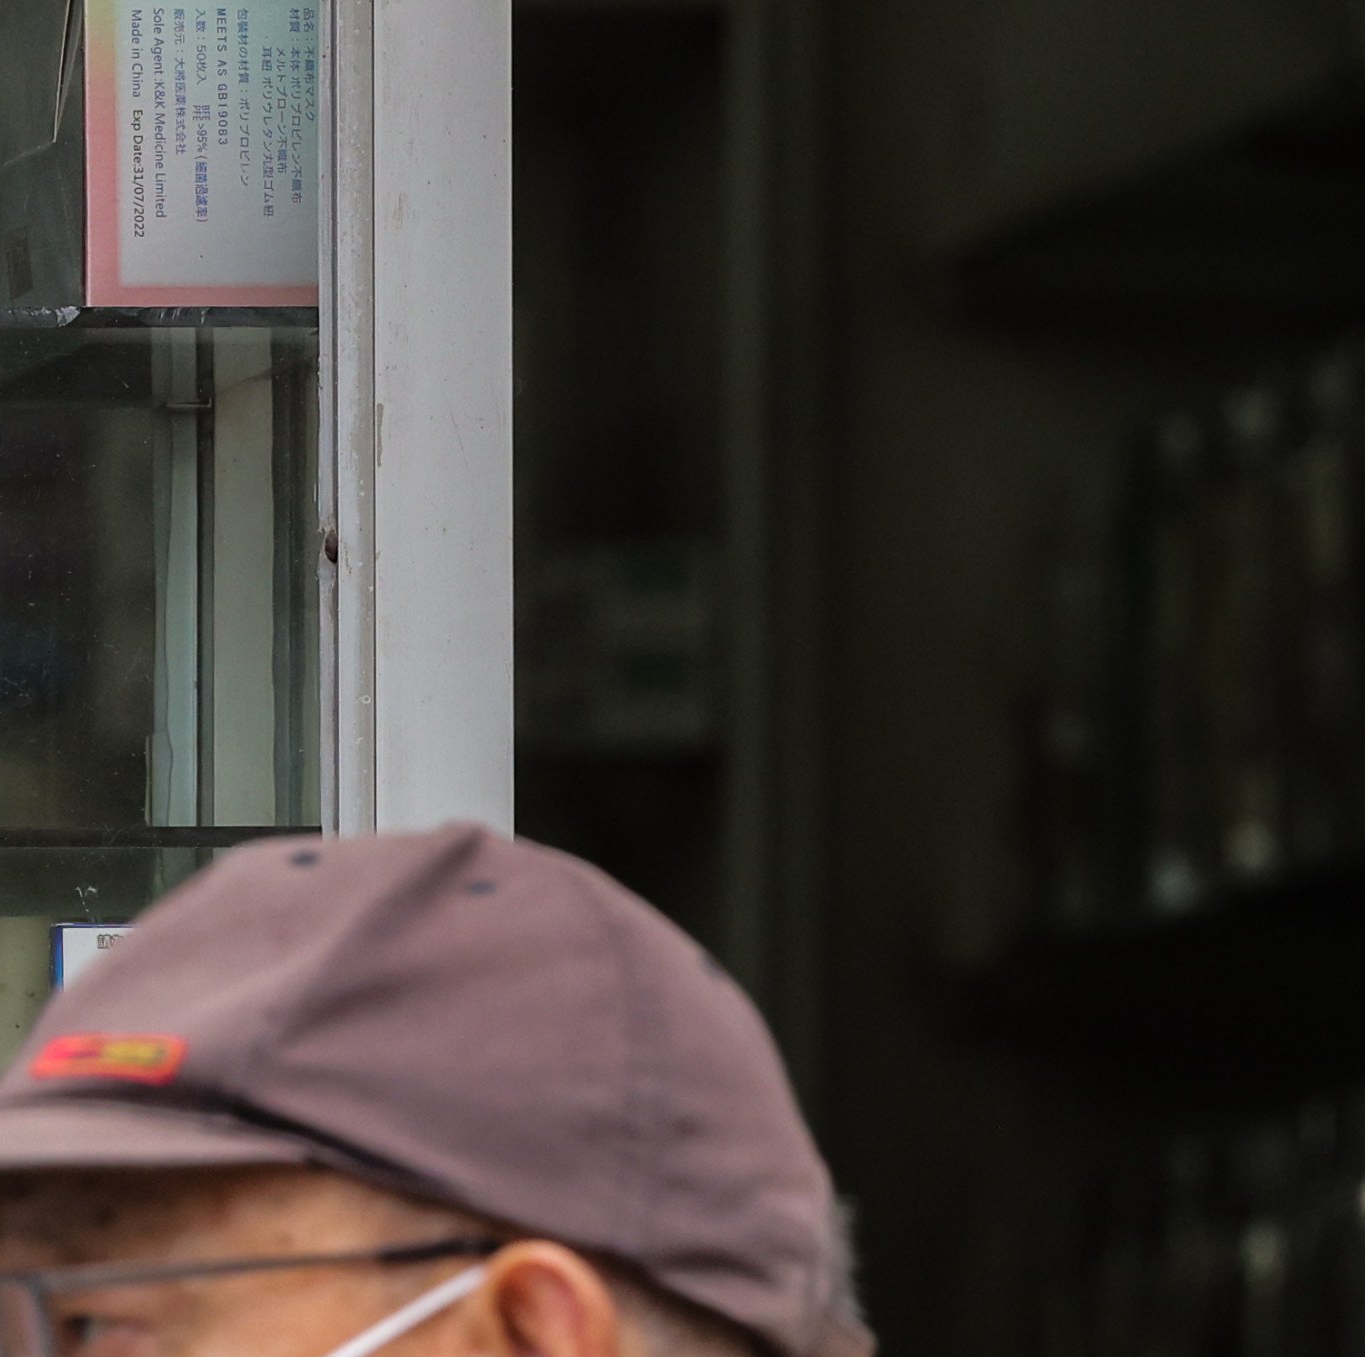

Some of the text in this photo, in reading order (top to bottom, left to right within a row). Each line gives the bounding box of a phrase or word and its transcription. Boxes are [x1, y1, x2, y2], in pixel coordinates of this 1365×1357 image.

[130, 9, 141, 43] Made
[151, 8, 163, 33] Sole
[215, 8, 226, 52] MEETS
[131, 48, 141, 59] in
[150, 38, 163, 74] Agent
[216, 60, 226, 76] AS
[131, 63, 142, 98] China
[130, 109, 142, 131] Exp
[153, 113, 164, 169] Medicine
[154, 173, 165, 218] Limited
